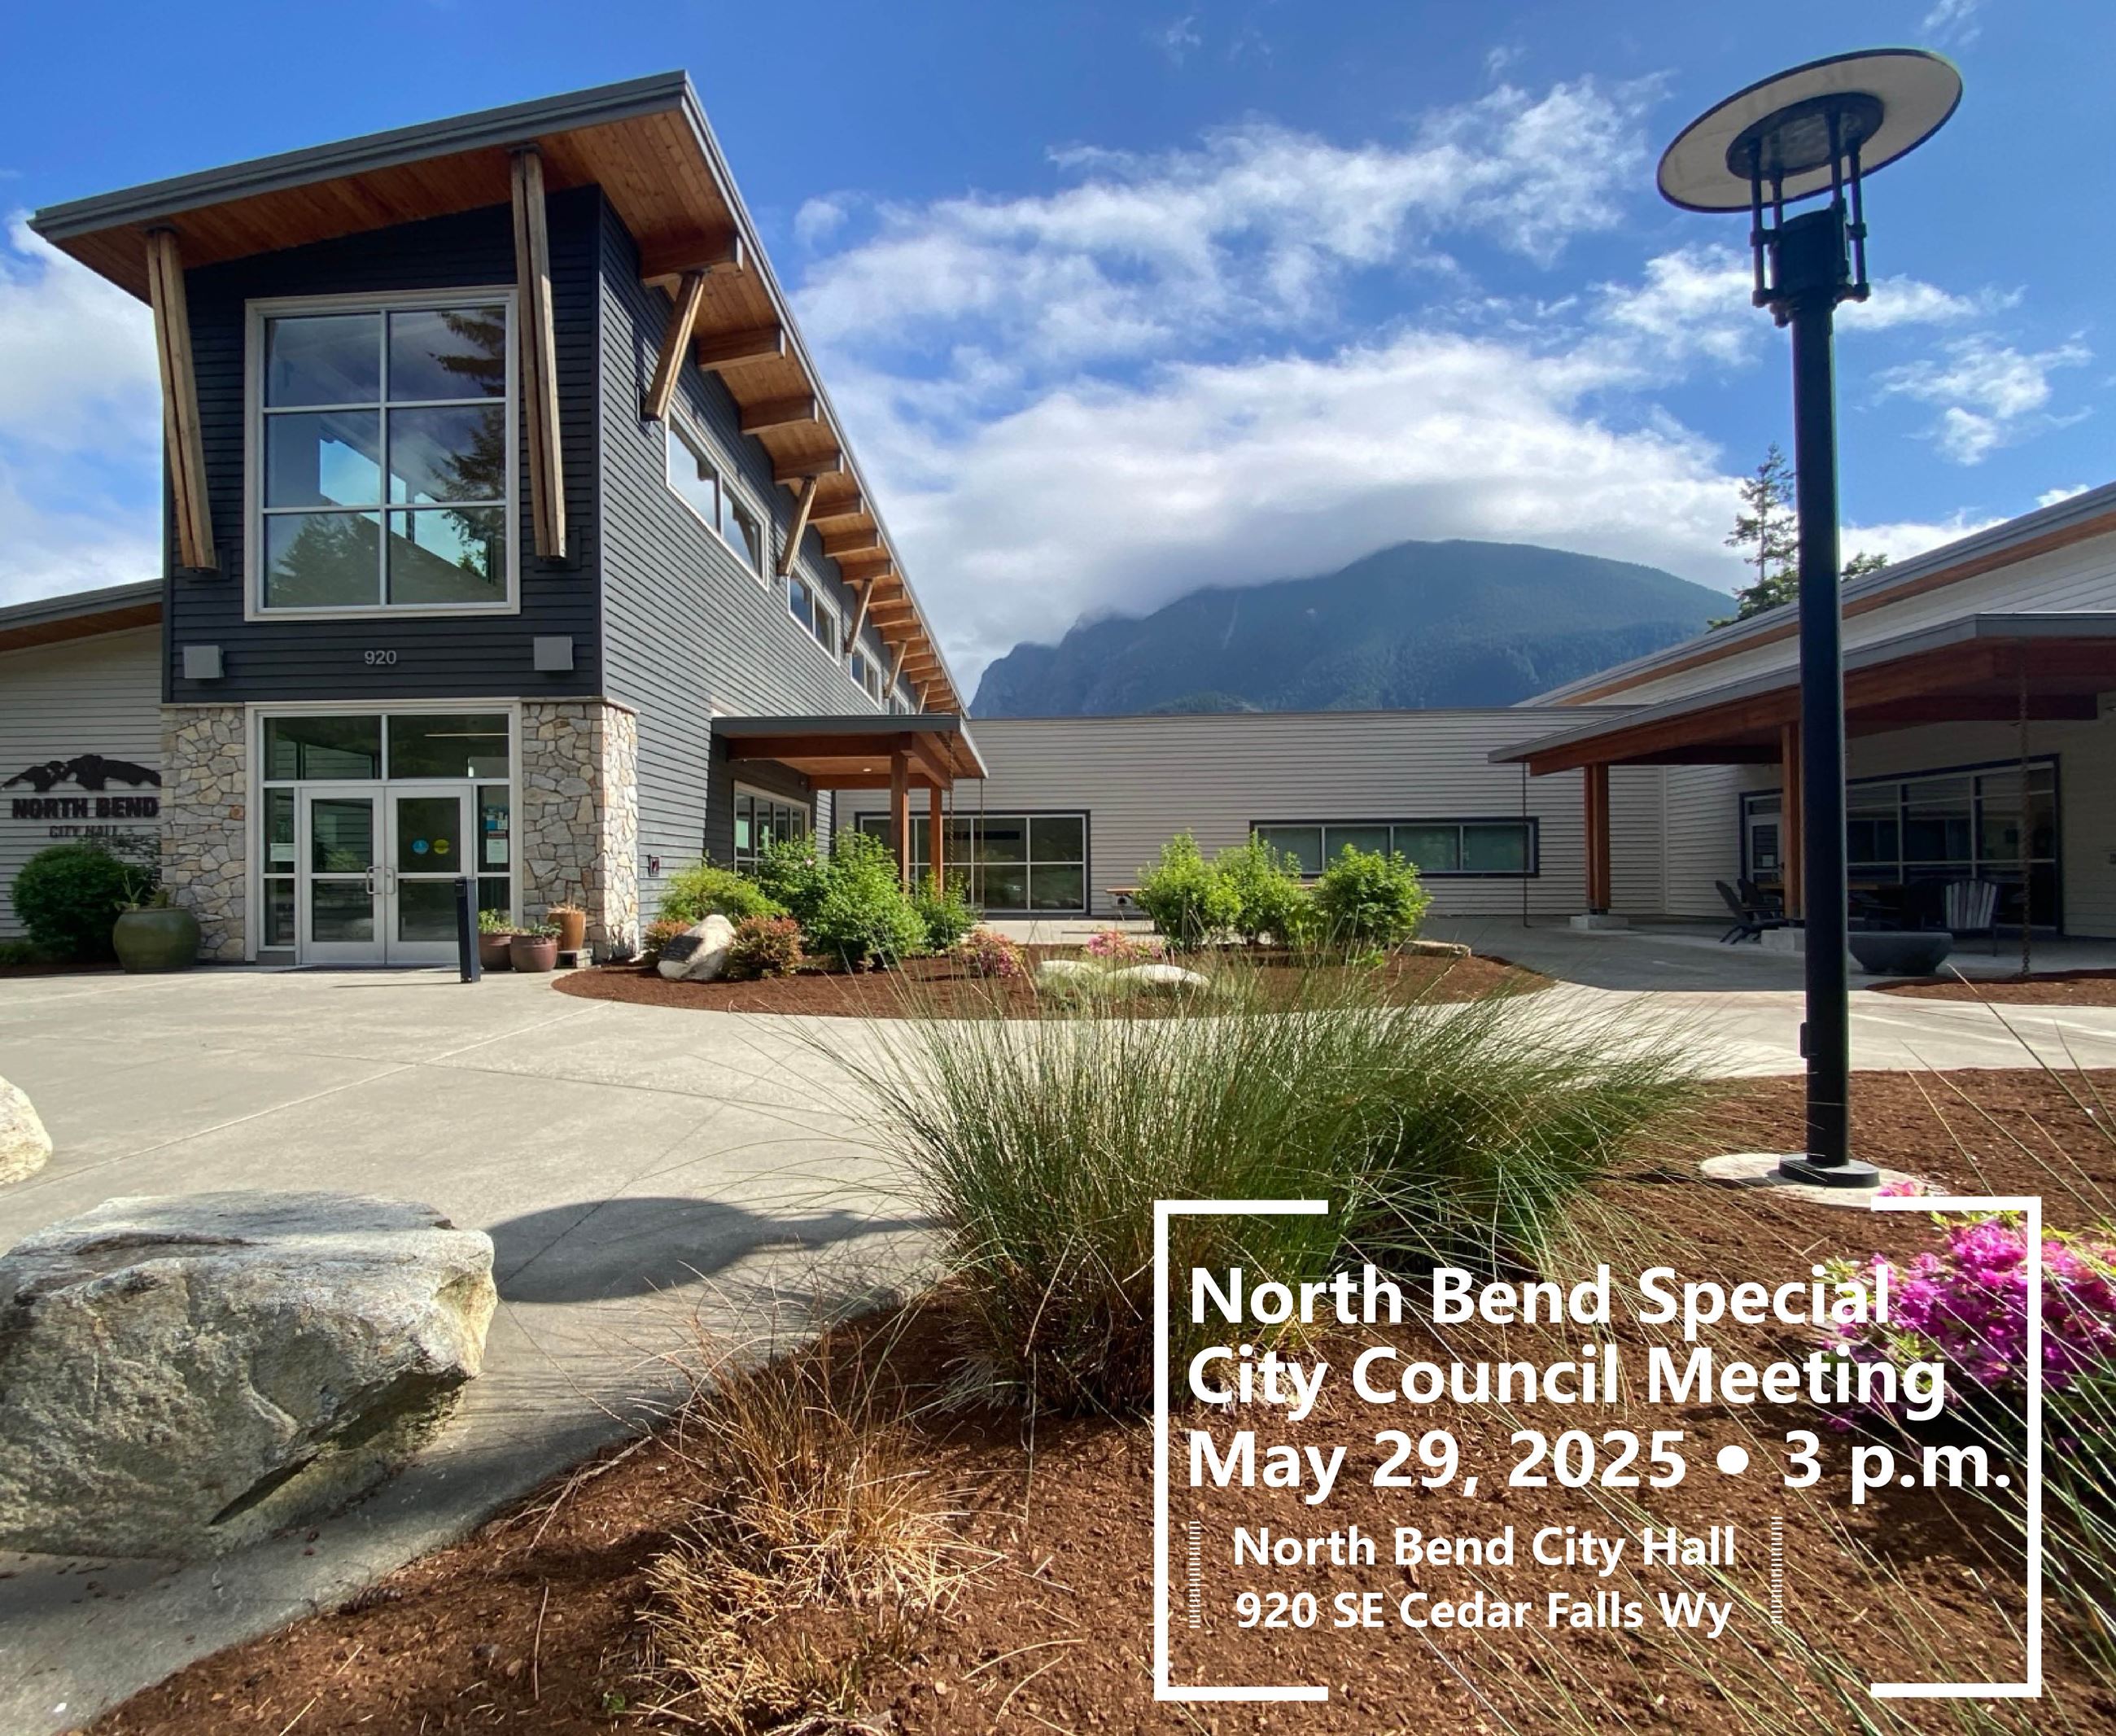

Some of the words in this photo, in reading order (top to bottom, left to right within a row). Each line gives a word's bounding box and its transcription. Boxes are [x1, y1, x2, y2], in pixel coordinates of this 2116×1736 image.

[365, 650, 397, 665] 920
[12, 798, 89, 819] NORTH
[96, 796, 160, 818] BEND
[50, 825, 80, 838] CITY
